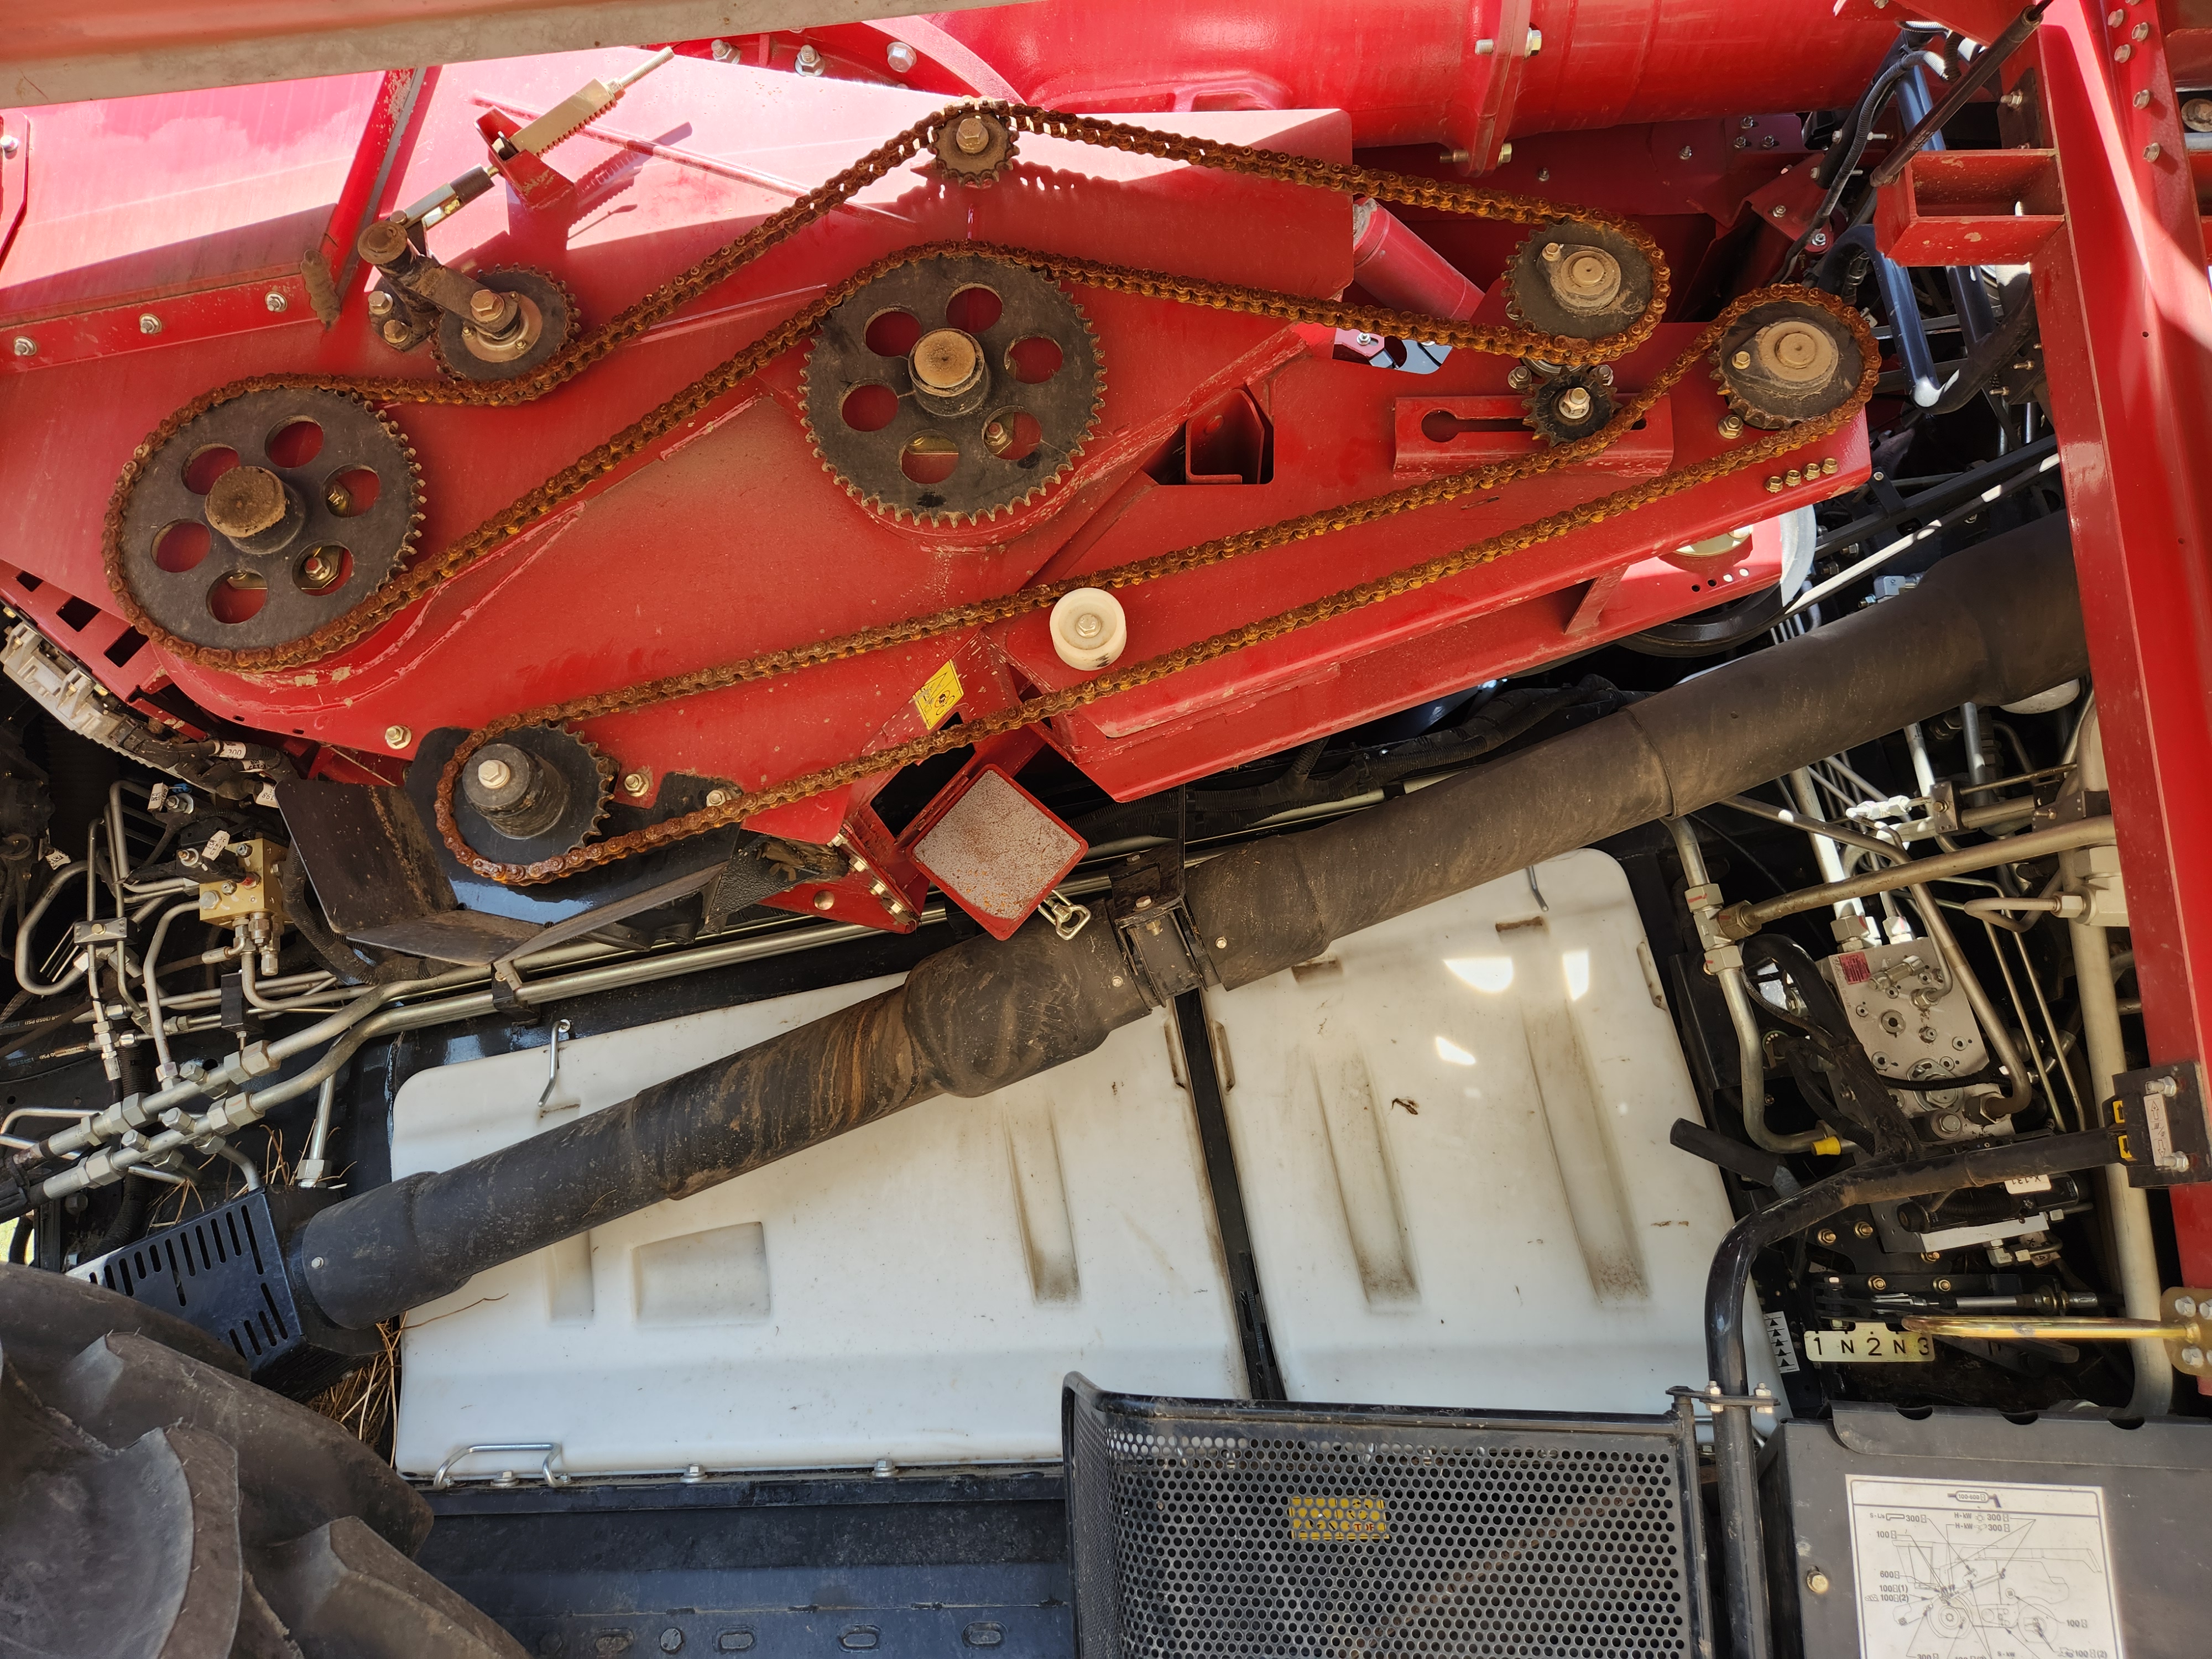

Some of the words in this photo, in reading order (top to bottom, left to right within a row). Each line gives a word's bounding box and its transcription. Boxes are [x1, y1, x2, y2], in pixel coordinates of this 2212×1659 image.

[1813, 1337, 1822, 1355] 1
[1840, 1339, 1854, 1354] N
[1866, 1338, 1882, 1356] 2
[1893, 1339, 1906, 1354] N
[1917, 1337, 1929, 1355] 3
